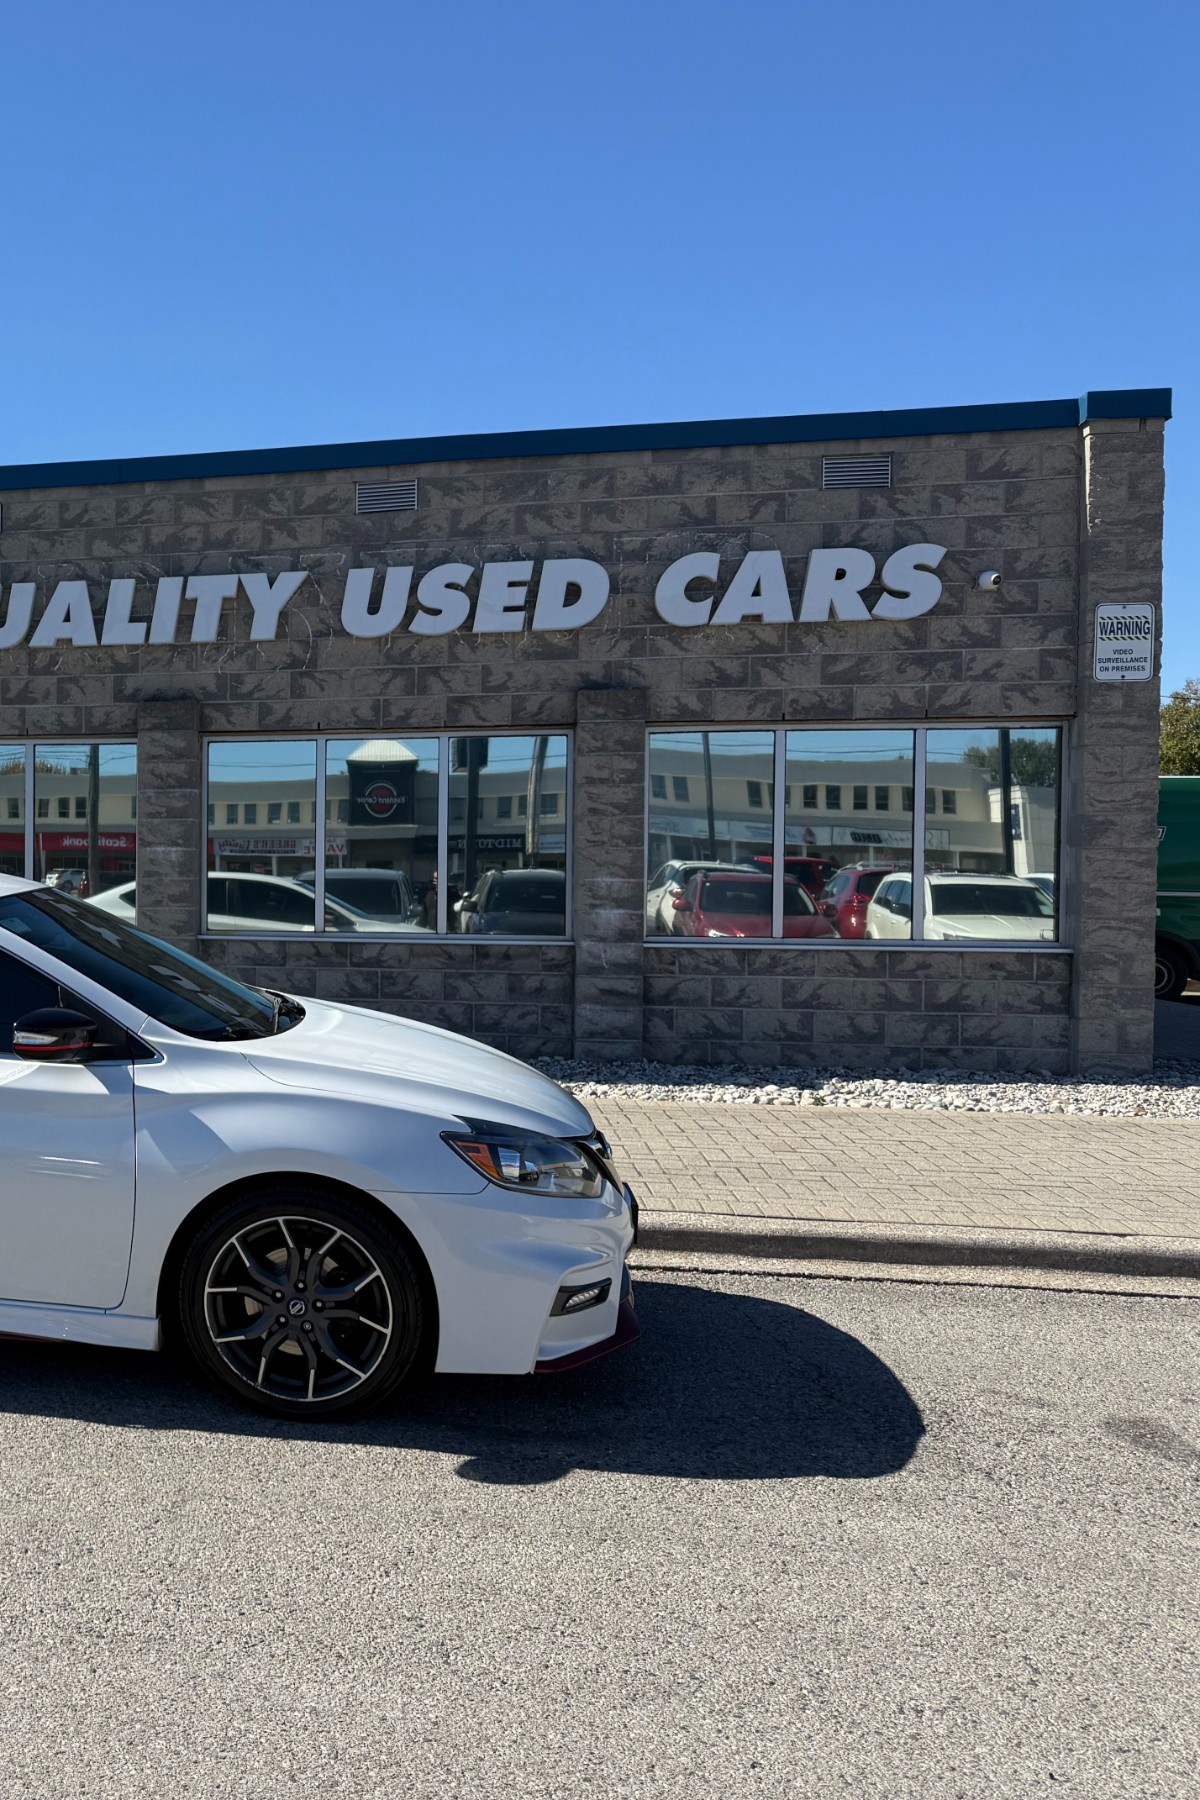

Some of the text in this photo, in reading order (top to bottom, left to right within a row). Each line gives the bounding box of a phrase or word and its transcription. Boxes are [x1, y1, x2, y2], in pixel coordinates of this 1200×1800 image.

[341, 558, 610, 638] USED
[654, 543, 948, 627] CARS
[1099, 620, 1151, 636] WARNING
[1097, 656, 1149, 664] SURVEILLANCE
[1099, 665, 1110, 673] ON
